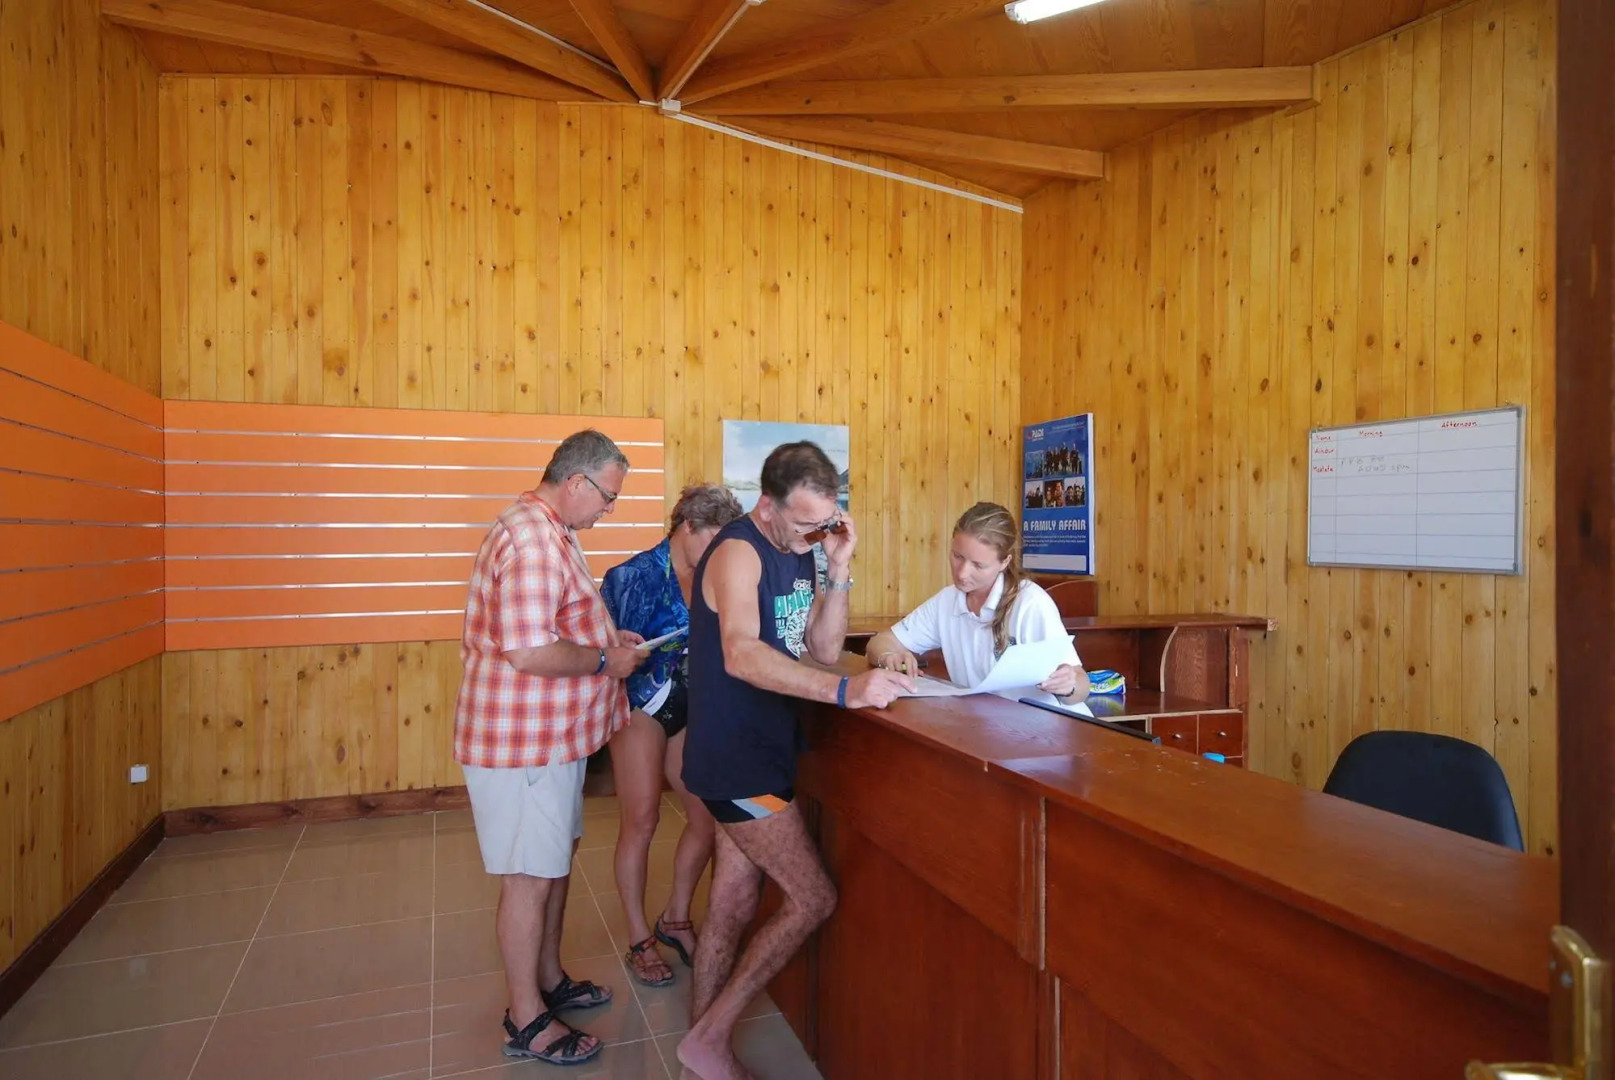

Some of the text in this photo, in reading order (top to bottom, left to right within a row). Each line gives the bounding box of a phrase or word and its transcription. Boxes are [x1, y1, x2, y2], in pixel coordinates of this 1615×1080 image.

[1023, 518, 1087, 531] A FAMILY AFFAIR
